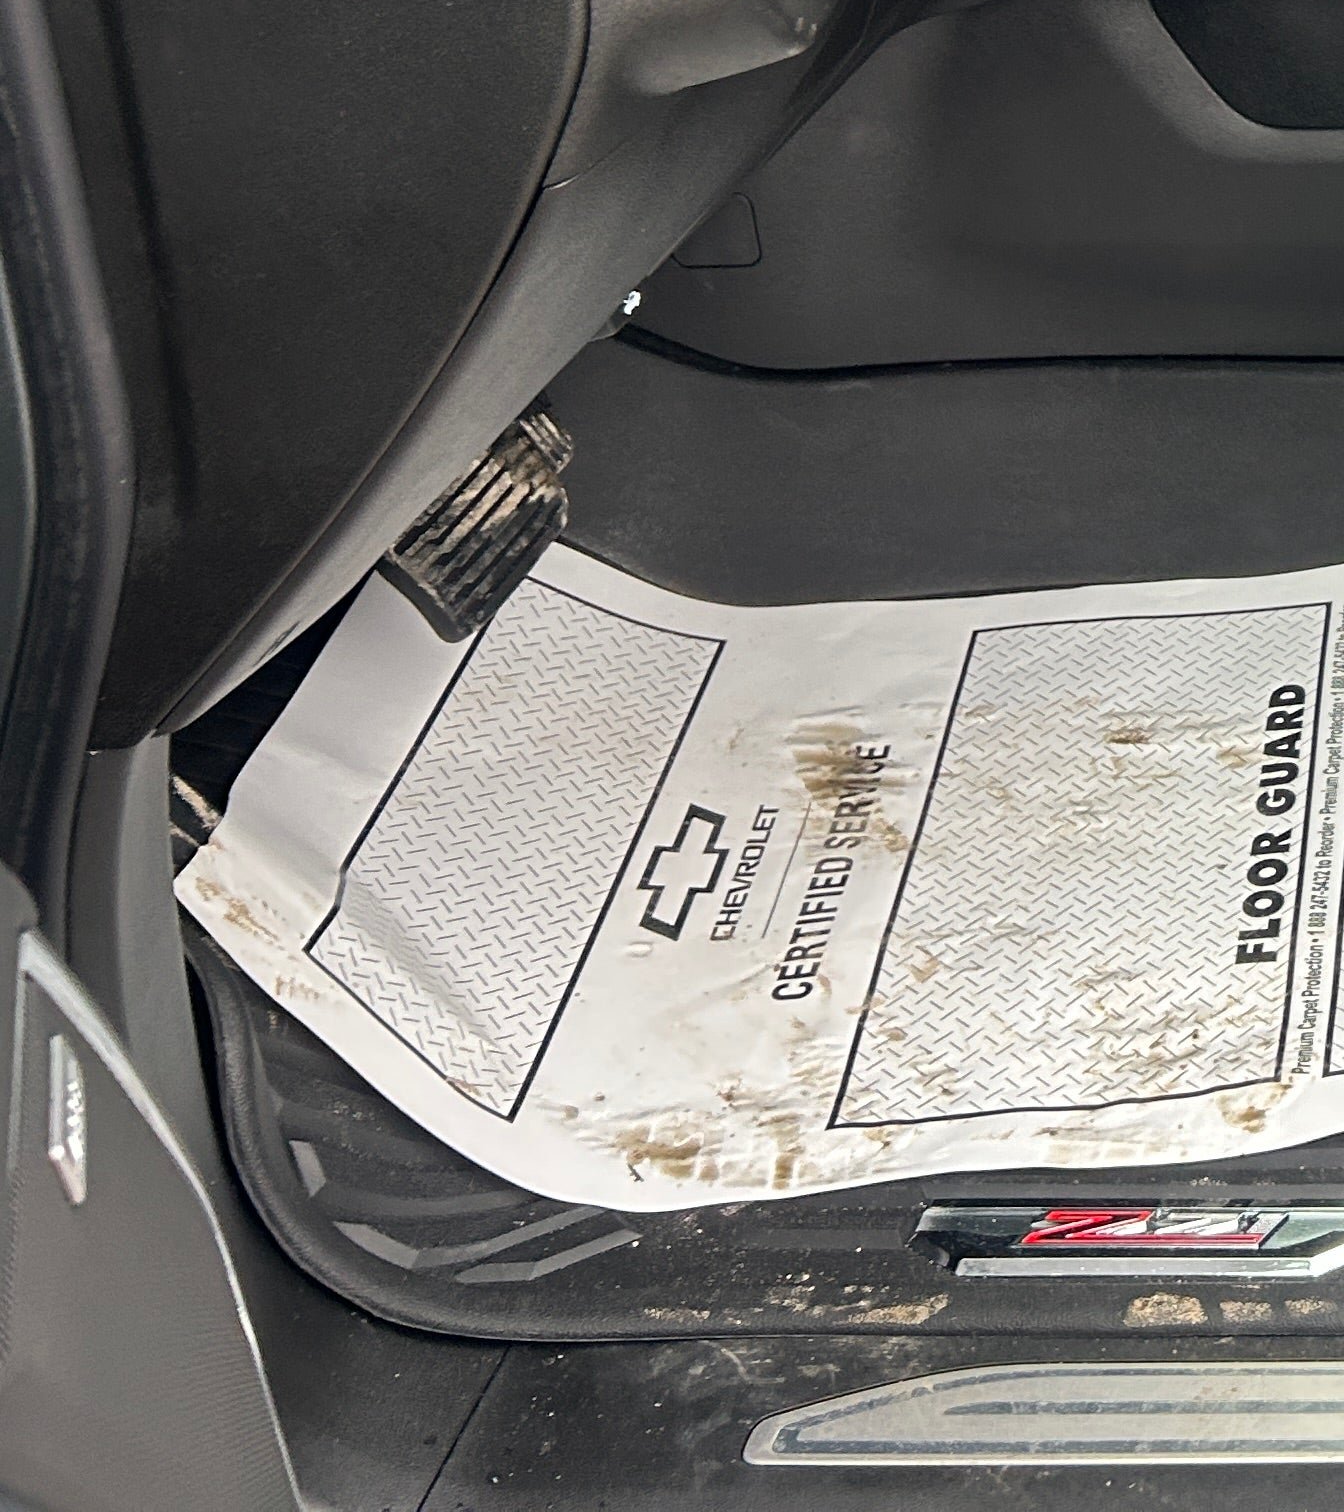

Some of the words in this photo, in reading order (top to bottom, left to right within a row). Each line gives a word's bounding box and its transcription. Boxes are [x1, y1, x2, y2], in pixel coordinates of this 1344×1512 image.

[1325, 702, 1344, 744] Protection
[1256, 684, 1306, 816] GUARD
[1323, 745, 1344, 774] Carpet
[1320, 775, 1339, 815] Premium
[1316, 820, 1335, 857] Reorder
[710, 804, 780, 941] CHEVROLET
[771, 856, 854, 1001] CERTIFIED
[823, 743, 892, 850] SERVICE
[1317, 858, 1331, 869] to
[1235, 827, 1292, 965] FLOOR
[1309, 869, 1331, 913] 247-5432
[1301, 943, 1324, 997] Protection
[1298, 999, 1323, 1030] Carpet
[1291, 1032, 1314, 1075] Premium
